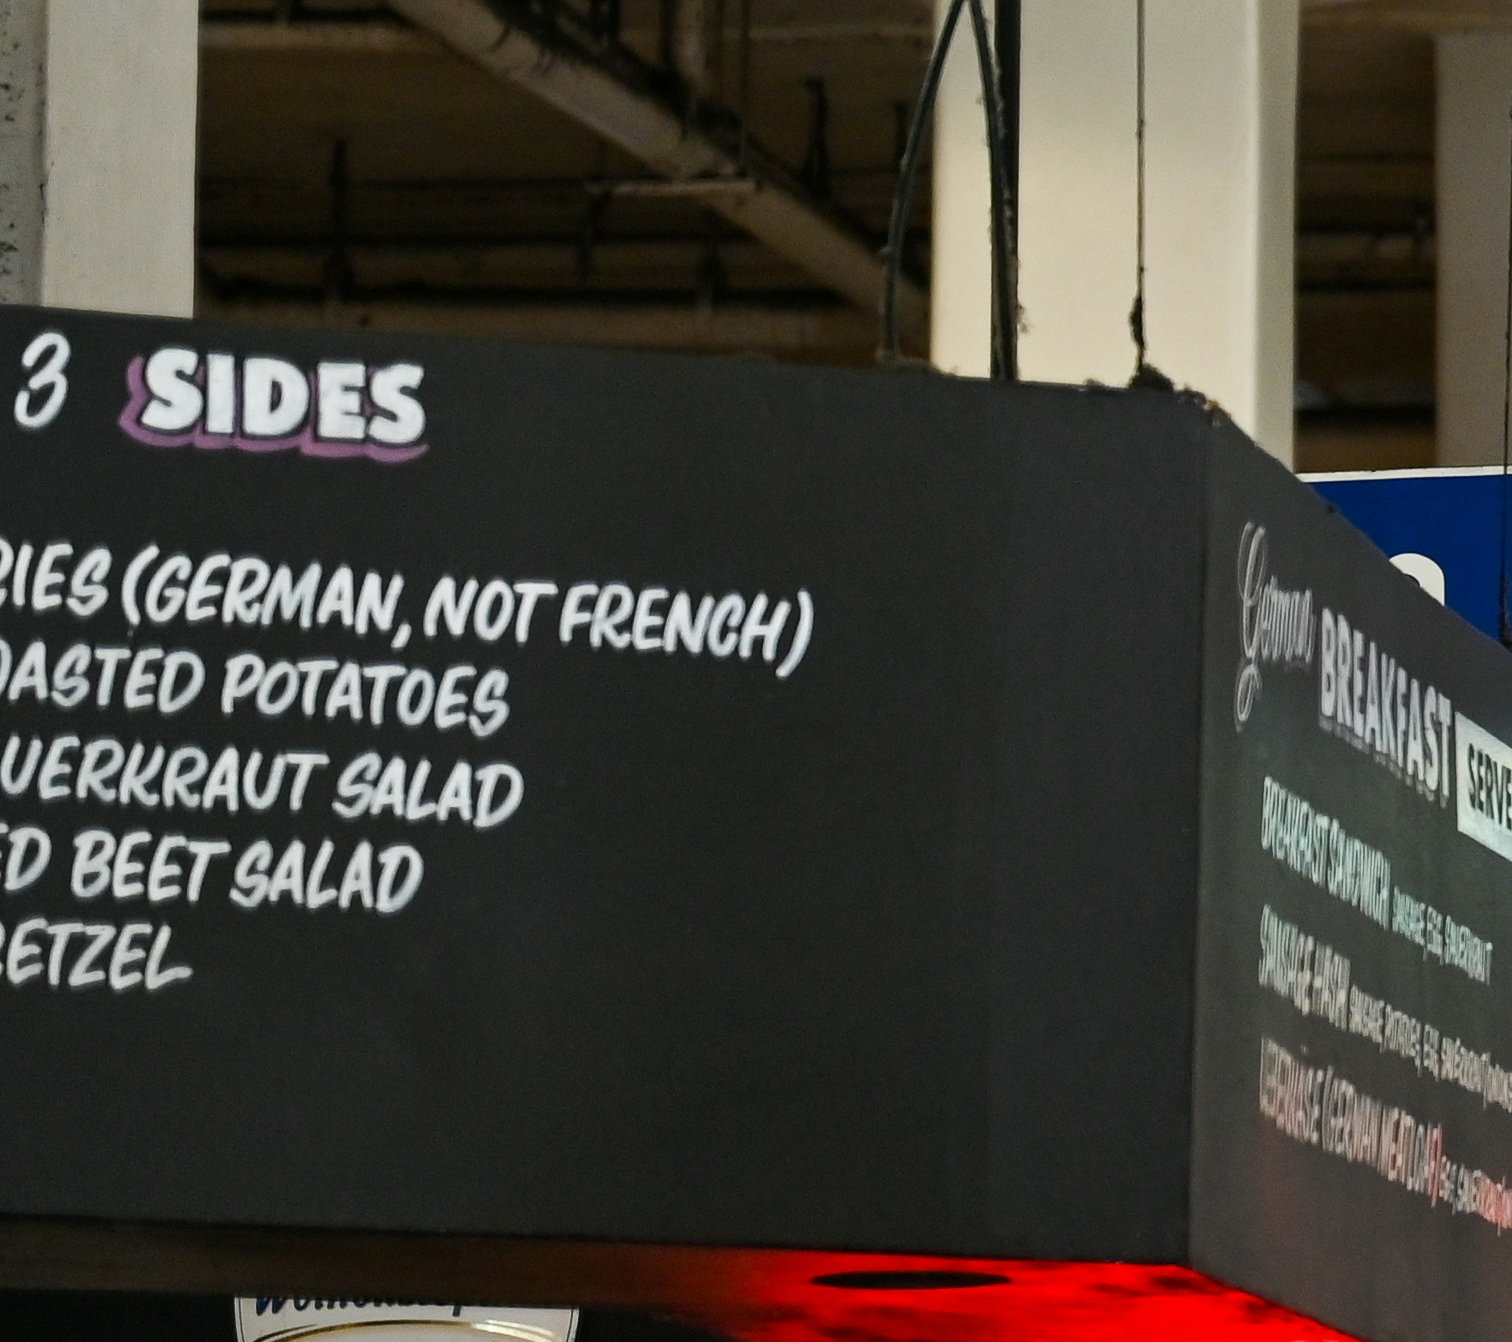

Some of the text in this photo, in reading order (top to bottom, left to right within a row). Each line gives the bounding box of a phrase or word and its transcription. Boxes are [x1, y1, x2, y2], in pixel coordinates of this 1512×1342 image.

[14, 332, 428, 453] 3 SIDES
[121, 544, 410, 648] (GERMAN,
[424, 577, 557, 643] NOT
[560, 581, 815, 678] FRENCH)
[222, 653, 510, 738] POTATOES
[1321, 608, 1450, 797] BREAKFAST
[333, 754, 525, 830] SALAD
[70, 828, 230, 903] BEET
[229, 839, 424, 914] SALAD
